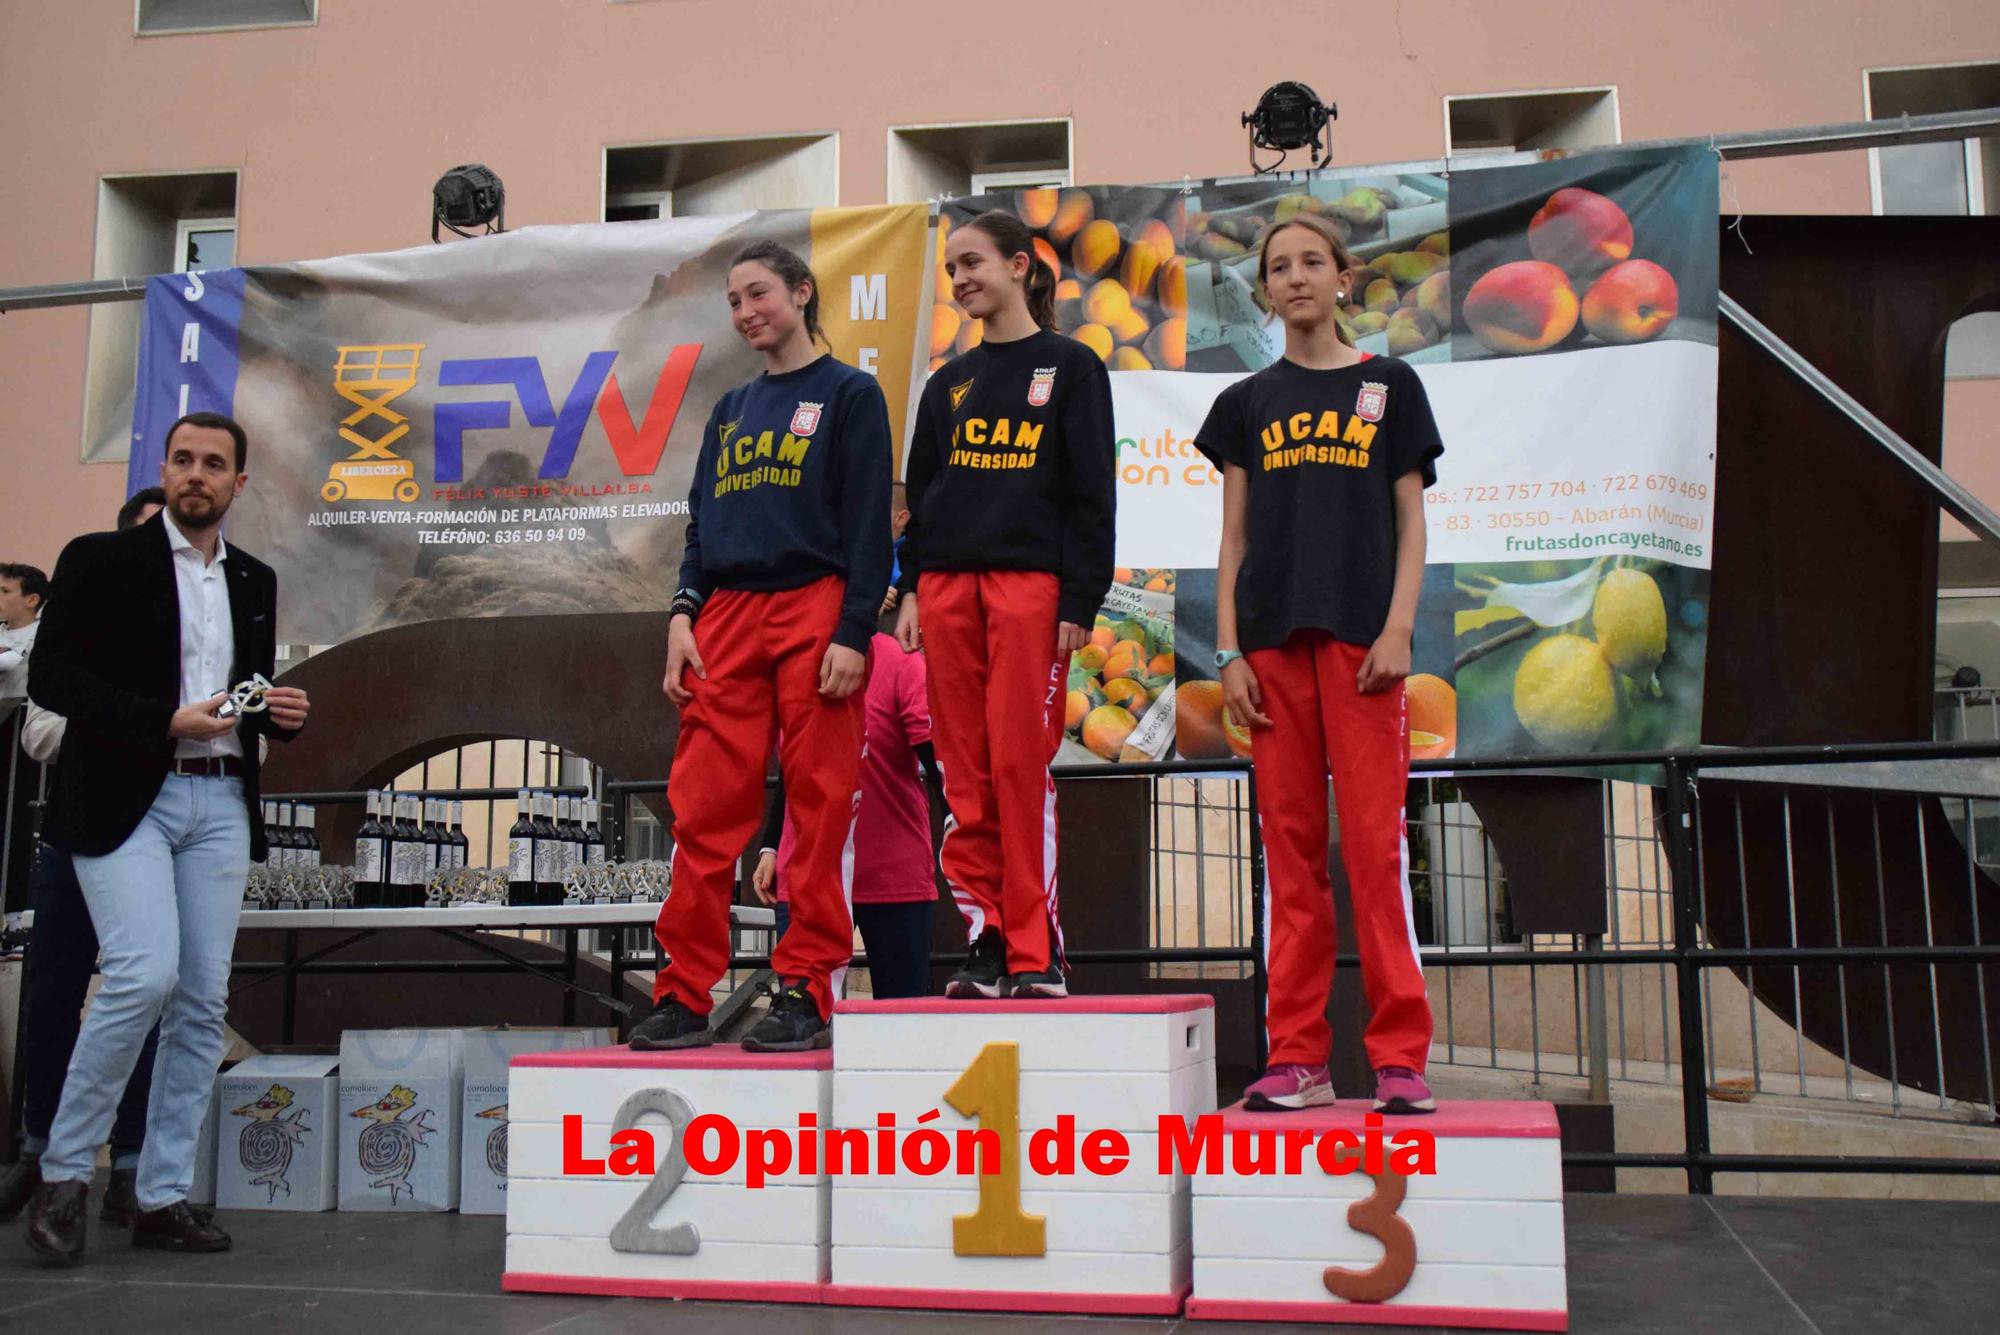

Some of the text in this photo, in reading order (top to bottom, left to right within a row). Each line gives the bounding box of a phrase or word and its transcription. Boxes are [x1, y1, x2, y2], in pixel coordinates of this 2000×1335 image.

[1261, 410, 1378, 451] UCAM
[716, 431, 811, 478] UCAM
[1263, 444, 1369, 472] UNIVERSIDAD
[433, 482, 653, 501] FÉLIX YUSTE VILLALBA
[714, 466, 802, 498] UNIVERSIDAD
[1464, 487, 1500, 502] 722
[1506, 484, 1542, 500] 757
[1550, 480, 1586, 497] 704
[1603, 475, 1639, 493] 722
[1646, 475, 1676, 493] 679
[1680, 480, 1707, 500] 469
[308, 506, 497, 527] ALQUILER-VENTA-FORMACIÓN
[501, 509, 519, 523] DE
[523, 505, 618, 522] PLATAFORMAS
[1447, 504, 1704, 531] 83 30550 Abarán (Murcia)
[418, 528, 586, 545] TELÉFÓNO: 636 50 94 09
[1506, 531, 1703, 557] frutasdoncayetano.es
